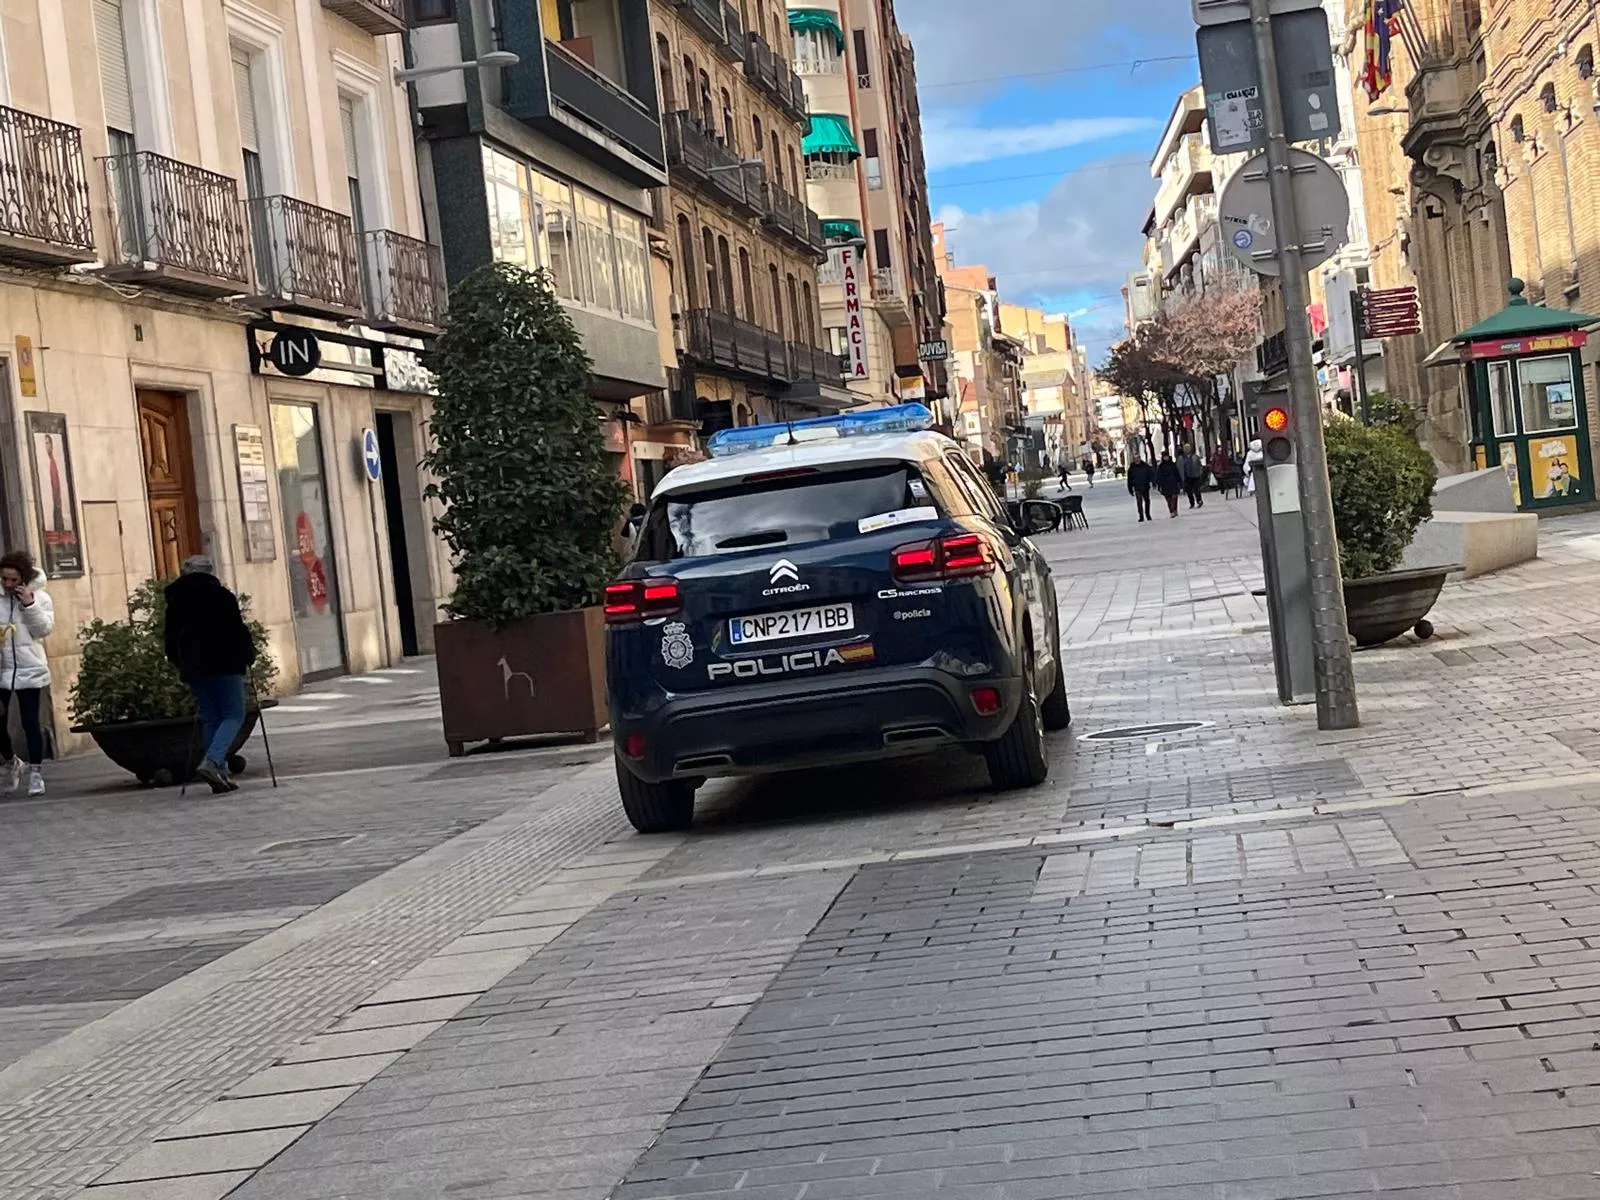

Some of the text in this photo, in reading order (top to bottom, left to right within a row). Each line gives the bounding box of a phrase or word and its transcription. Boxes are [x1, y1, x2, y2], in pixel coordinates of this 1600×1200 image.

[841, 250, 866, 377] FARMACIA
[280, 338, 309, 365] IN
[893, 608, 931, 620] @policia
[707, 648, 846, 681] POLICIA
